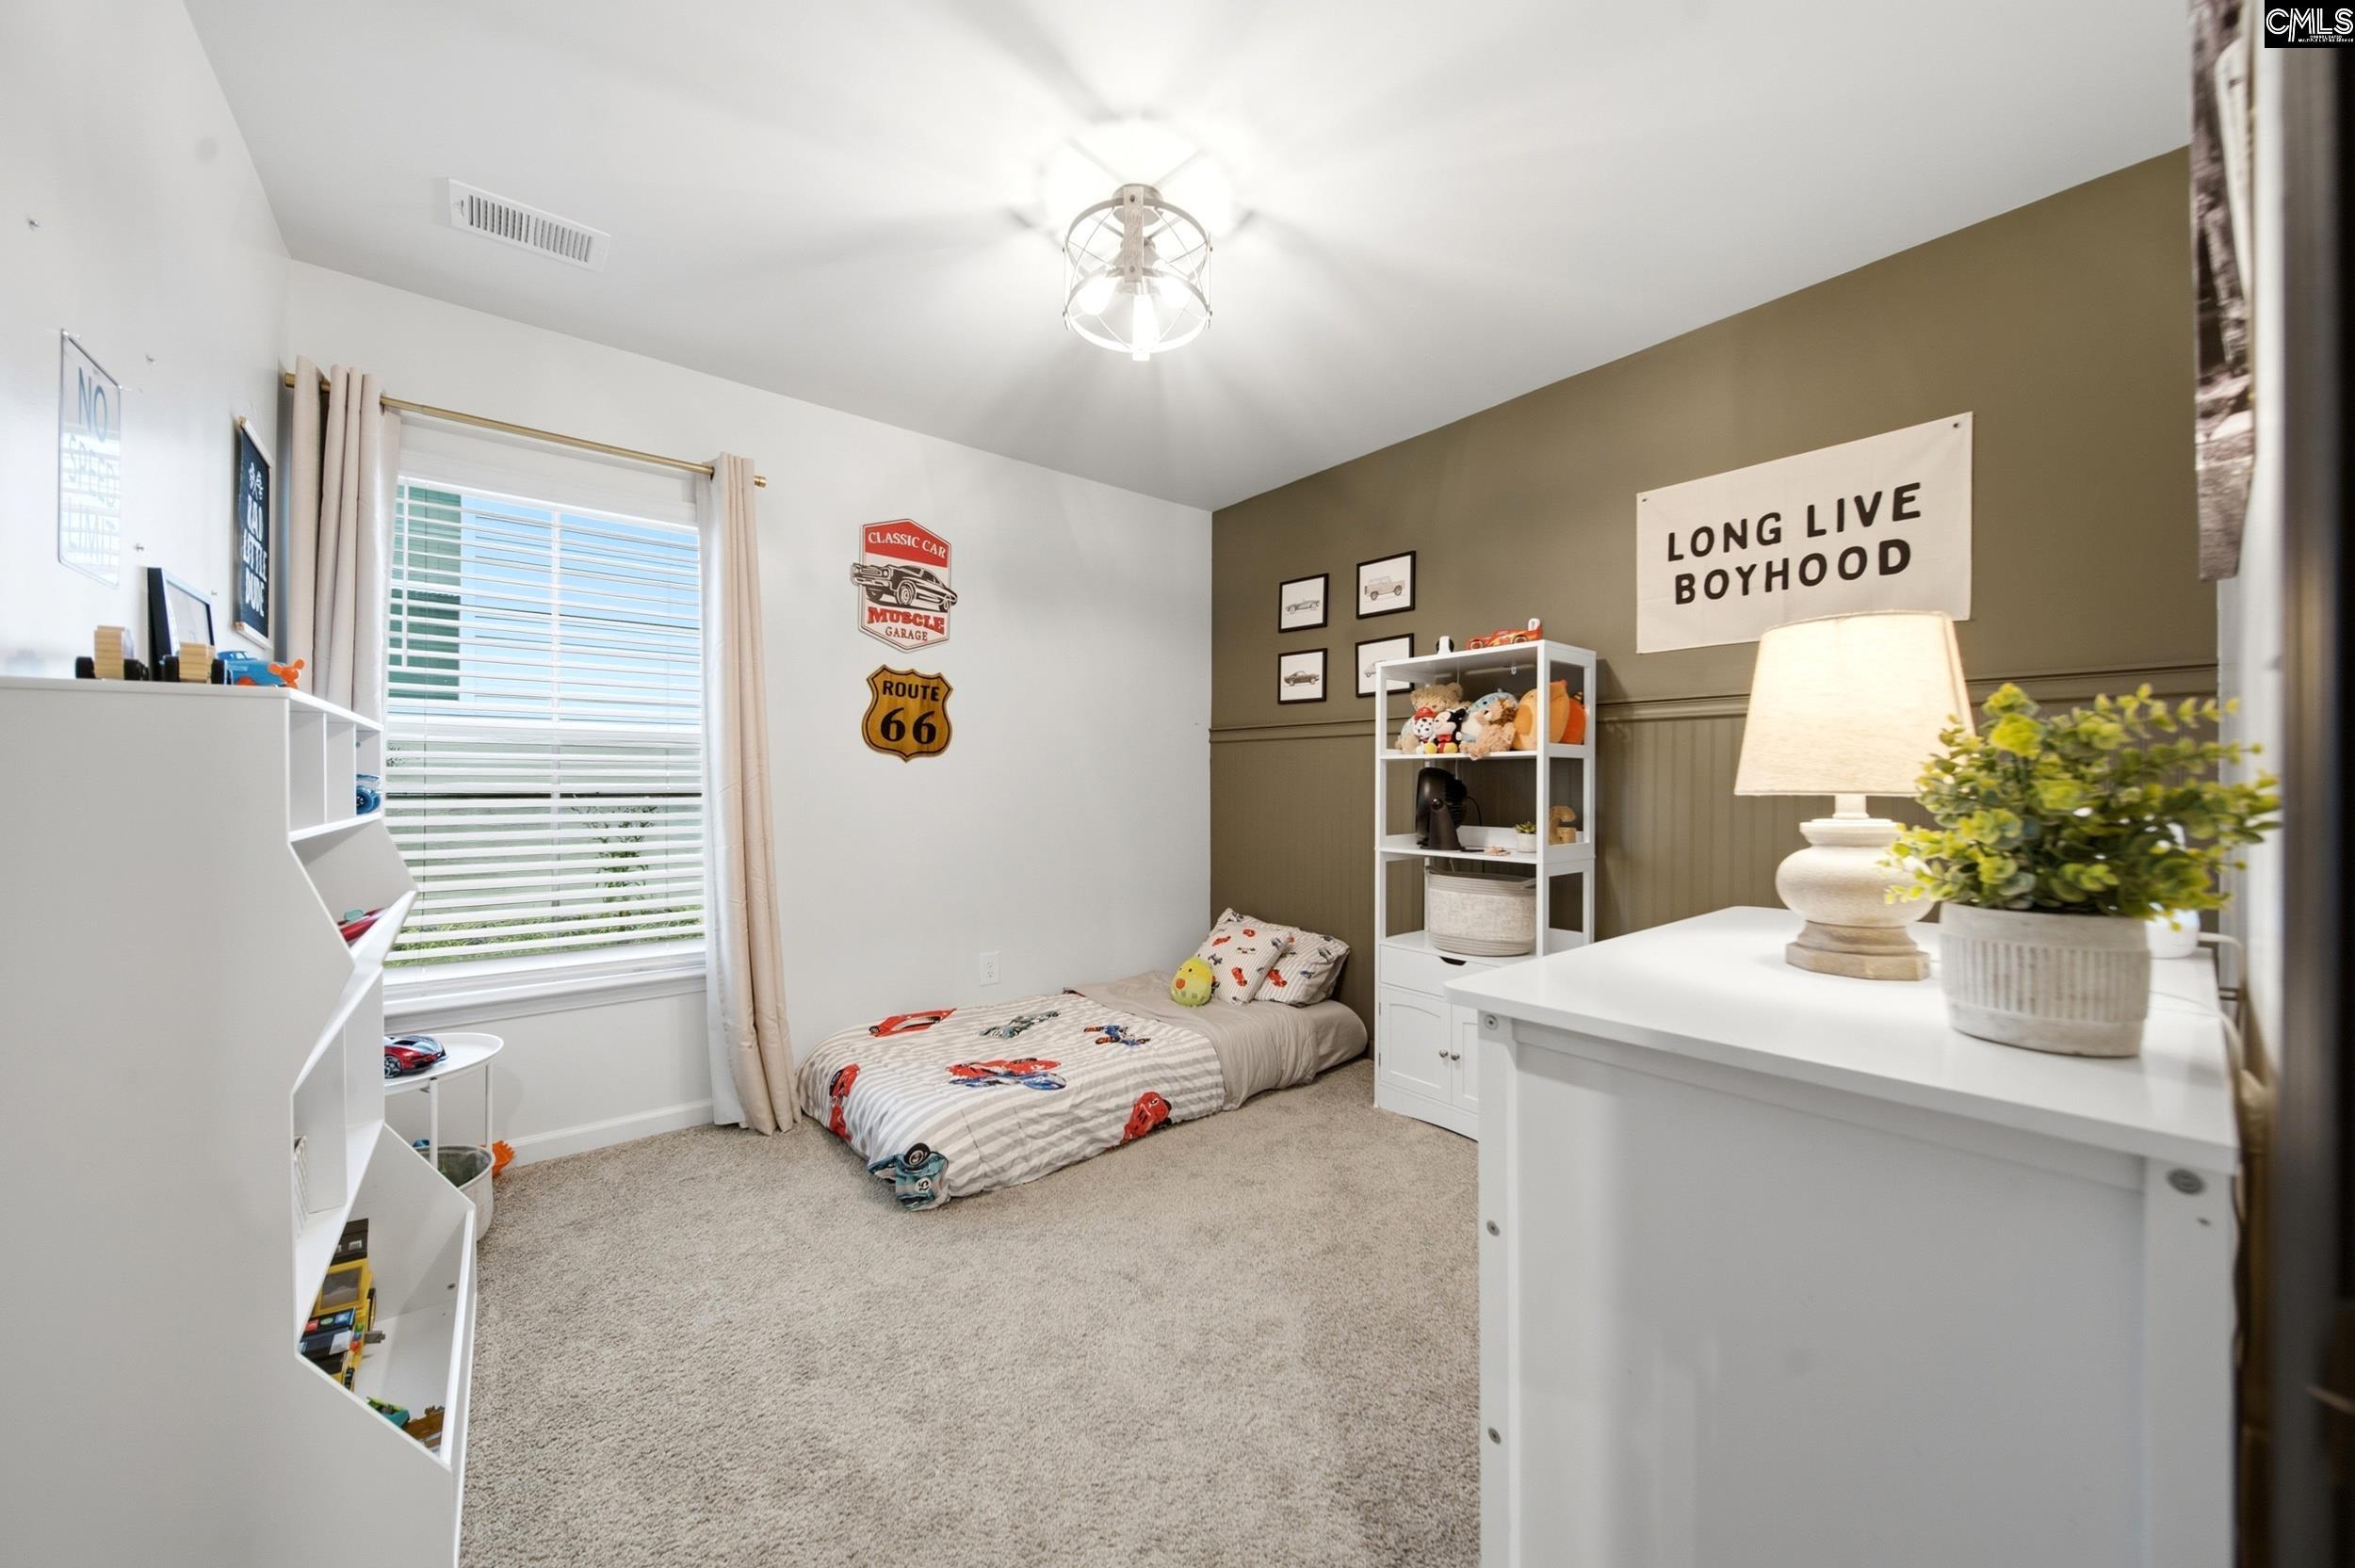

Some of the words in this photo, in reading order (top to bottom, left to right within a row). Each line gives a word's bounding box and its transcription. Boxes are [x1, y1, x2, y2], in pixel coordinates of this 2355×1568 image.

[78, 366, 107, 443] NO
[1667, 511, 1782, 562] LONG
[1806, 481, 1922, 538] LIVE
[243, 528, 268, 582] LITTLE
[868, 531, 920, 548] CLASSIC
[922, 540, 947, 558] CAR
[246, 565, 264, 617] DUDE
[1675, 538, 1912, 606] BOYHOOD
[867, 606, 945, 636] MUSCLE
[885, 626, 929, 641] GARAGE
[882, 680, 940, 702] ROUTE
[880, 707, 936, 745] 66
